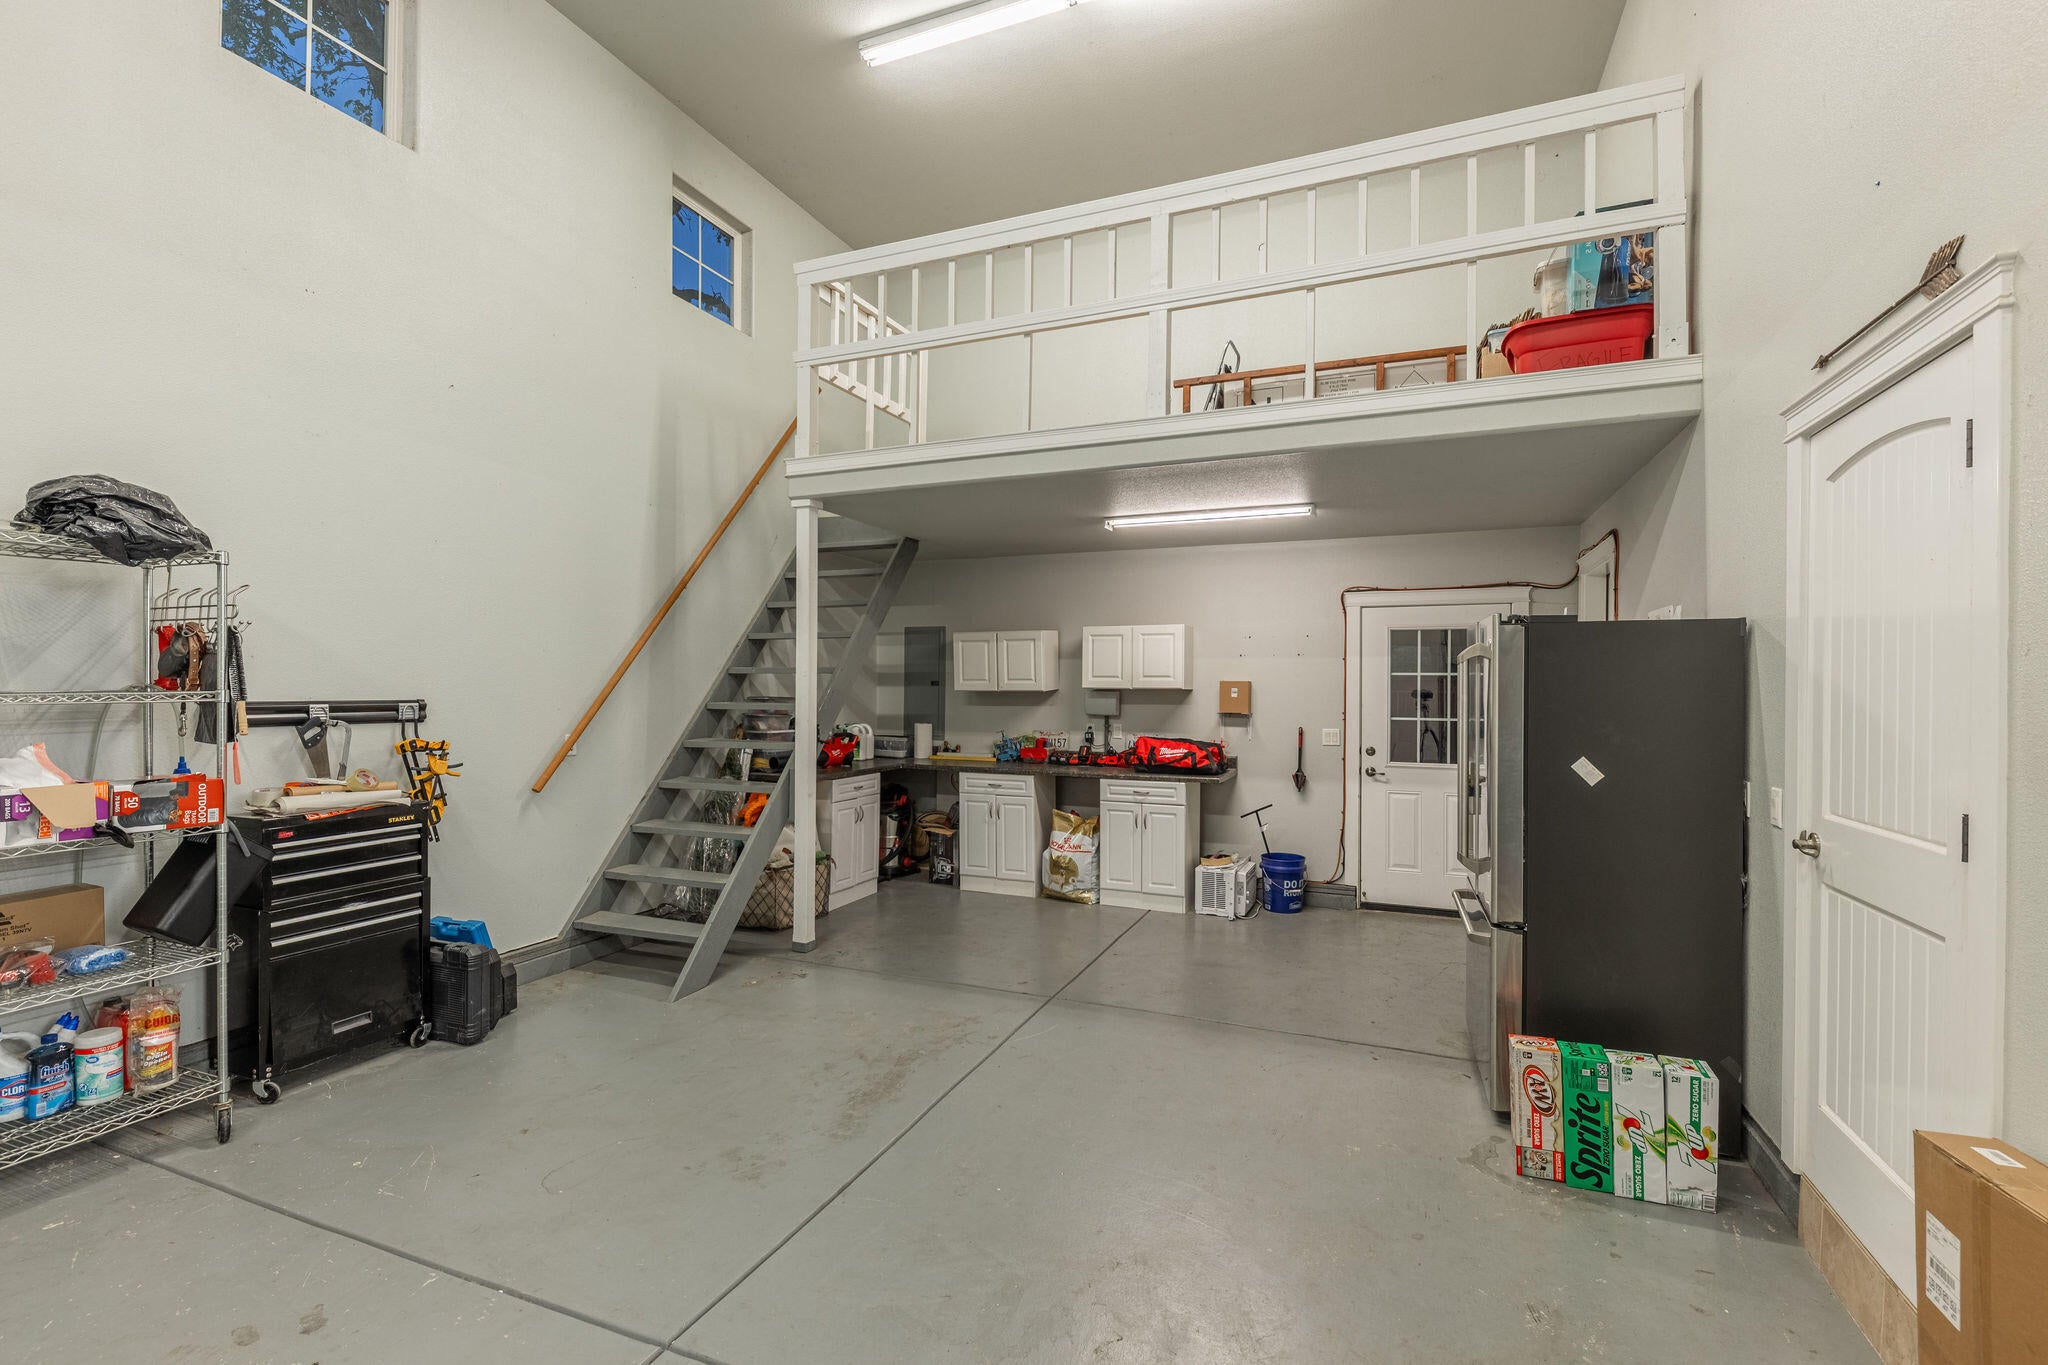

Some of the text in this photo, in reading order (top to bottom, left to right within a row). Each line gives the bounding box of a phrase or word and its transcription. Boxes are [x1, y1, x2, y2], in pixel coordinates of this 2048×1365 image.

[19, 801, 31, 813] 13
[127, 796, 139, 809] 50
[197, 783, 207, 824] OUTDOOR
[182, 809, 192, 825] Bags
[388, 815, 415, 824] STANLEY
[1283, 880, 1298, 889] DO
[41, 1061, 70, 1077] finish
[1, 1084, 27, 1097] CLOR
[1526, 1074, 1555, 1107] A&W
[1691, 1079, 1700, 1122] ZERO SUGAR
[1533, 1112, 1541, 1146] ZERO SUGAR
[1567, 1092, 1610, 1189] Sprite
[1615, 1103, 1655, 1154] 7UP
[1602, 1148, 1610, 1166] ZERO
[1676, 1122, 1716, 1174] 7UP
[1634, 1155, 1643, 1198] ZERO SUGAR
